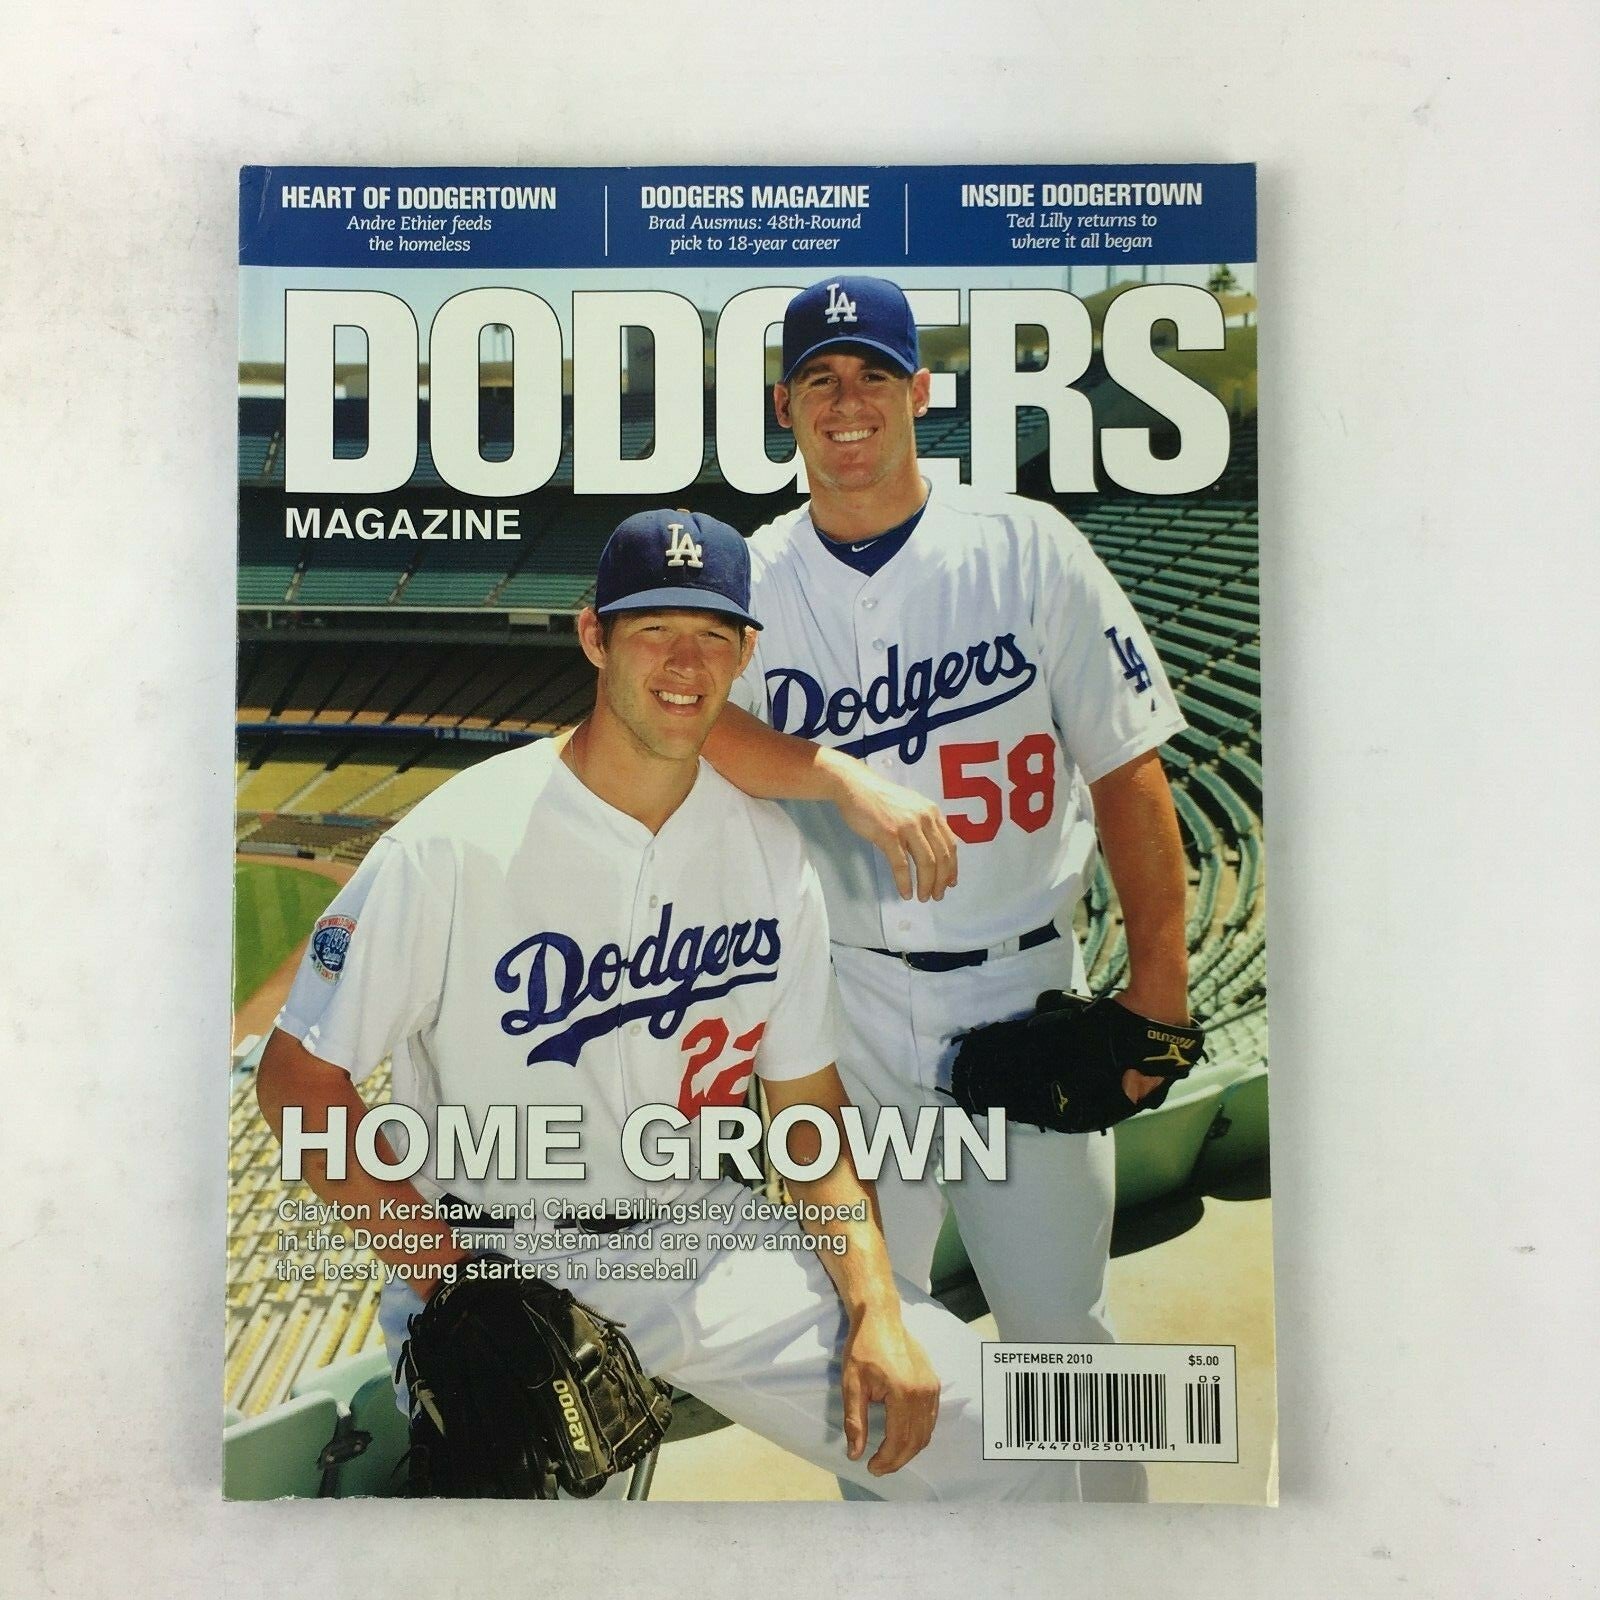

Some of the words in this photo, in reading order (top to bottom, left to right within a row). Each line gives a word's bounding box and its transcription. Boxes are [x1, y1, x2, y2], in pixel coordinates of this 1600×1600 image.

[282, 186, 356, 208] HEART
[363, 187, 391, 209] OF
[398, 187, 557, 210] DODGERTOWN
[641, 185, 744, 209] DODGERS
[752, 185, 870, 208] MAGAZINE
[961, 184, 1035, 207] INSIDE
[1042, 183, 1203, 207] DODGERTOWN
[346, 215, 396, 231] Andre
[400, 215, 448, 231] Ethier
[450, 215, 492, 235] feeds
[648, 214, 686, 230] Brad
[690, 215, 762, 230] Ausmus:
[766, 213, 862, 230] 48th-Round
[1006, 212, 1035, 228] Ted
[1040, 212, 1073, 232] Lilly
[1077, 214, 1137, 228] returns
[1141, 214, 1157, 228] to
[368, 236, 394, 252] the
[398, 236, 471, 252] homeless
[669, 235, 702, 255] pick
[707, 238, 723, 251] to
[728, 236, 788, 255] 18-year
[792, 238, 840, 251] career
[1011, 233, 1060, 249] where
[1065, 234, 1077, 249] it
[1081, 233, 1099, 249] all
[1105, 233, 1153, 252] began
[284, 507, 522, 541] MAGAZINE
[765, 633, 1037, 766] Dodgers
[938, 732, 1056, 844] 58
[494, 902, 781, 1041] Dodgers
[279, 1102, 587, 1182] HOME
[620, 1102, 1008, 1182] GROWN
[277, 1199, 371, 1225] Clayton
[379, 1198, 484, 1221] Kershaw
[490, 1198, 536, 1221] and
[543, 1198, 606, 1221] Chad
[614, 1198, 735, 1225] Billingsley
[741, 1199, 867, 1225] developed
[278, 1229, 299, 1251] in
[315, 1229, 346, 1251] the
[353, 1229, 444, 1255] Dodger
[451, 1228, 507, 1250] farm
[514, 1230, 598, 1255] system
[607, 1229, 653, 1250] and
[660, 1233, 699, 1251] are
[706, 1233, 758, 1251] now
[763, 1233, 848, 1255] among
[276, 1259, 316, 1281] the
[323, 1259, 379, 1281] best
[385, 1263, 458, 1285] young
[465, 1260, 560, 1281] starters
[566, 1259, 588, 1280] in
[595, 1258, 698, 1281] baseball
[994, 1353, 1064, 1365] SEPTEMBER
[1067, 1353, 1093, 1365] 2010
[1188, 1354, 1219, 1366] $5.00
[552, 1379, 591, 1452] A2000
